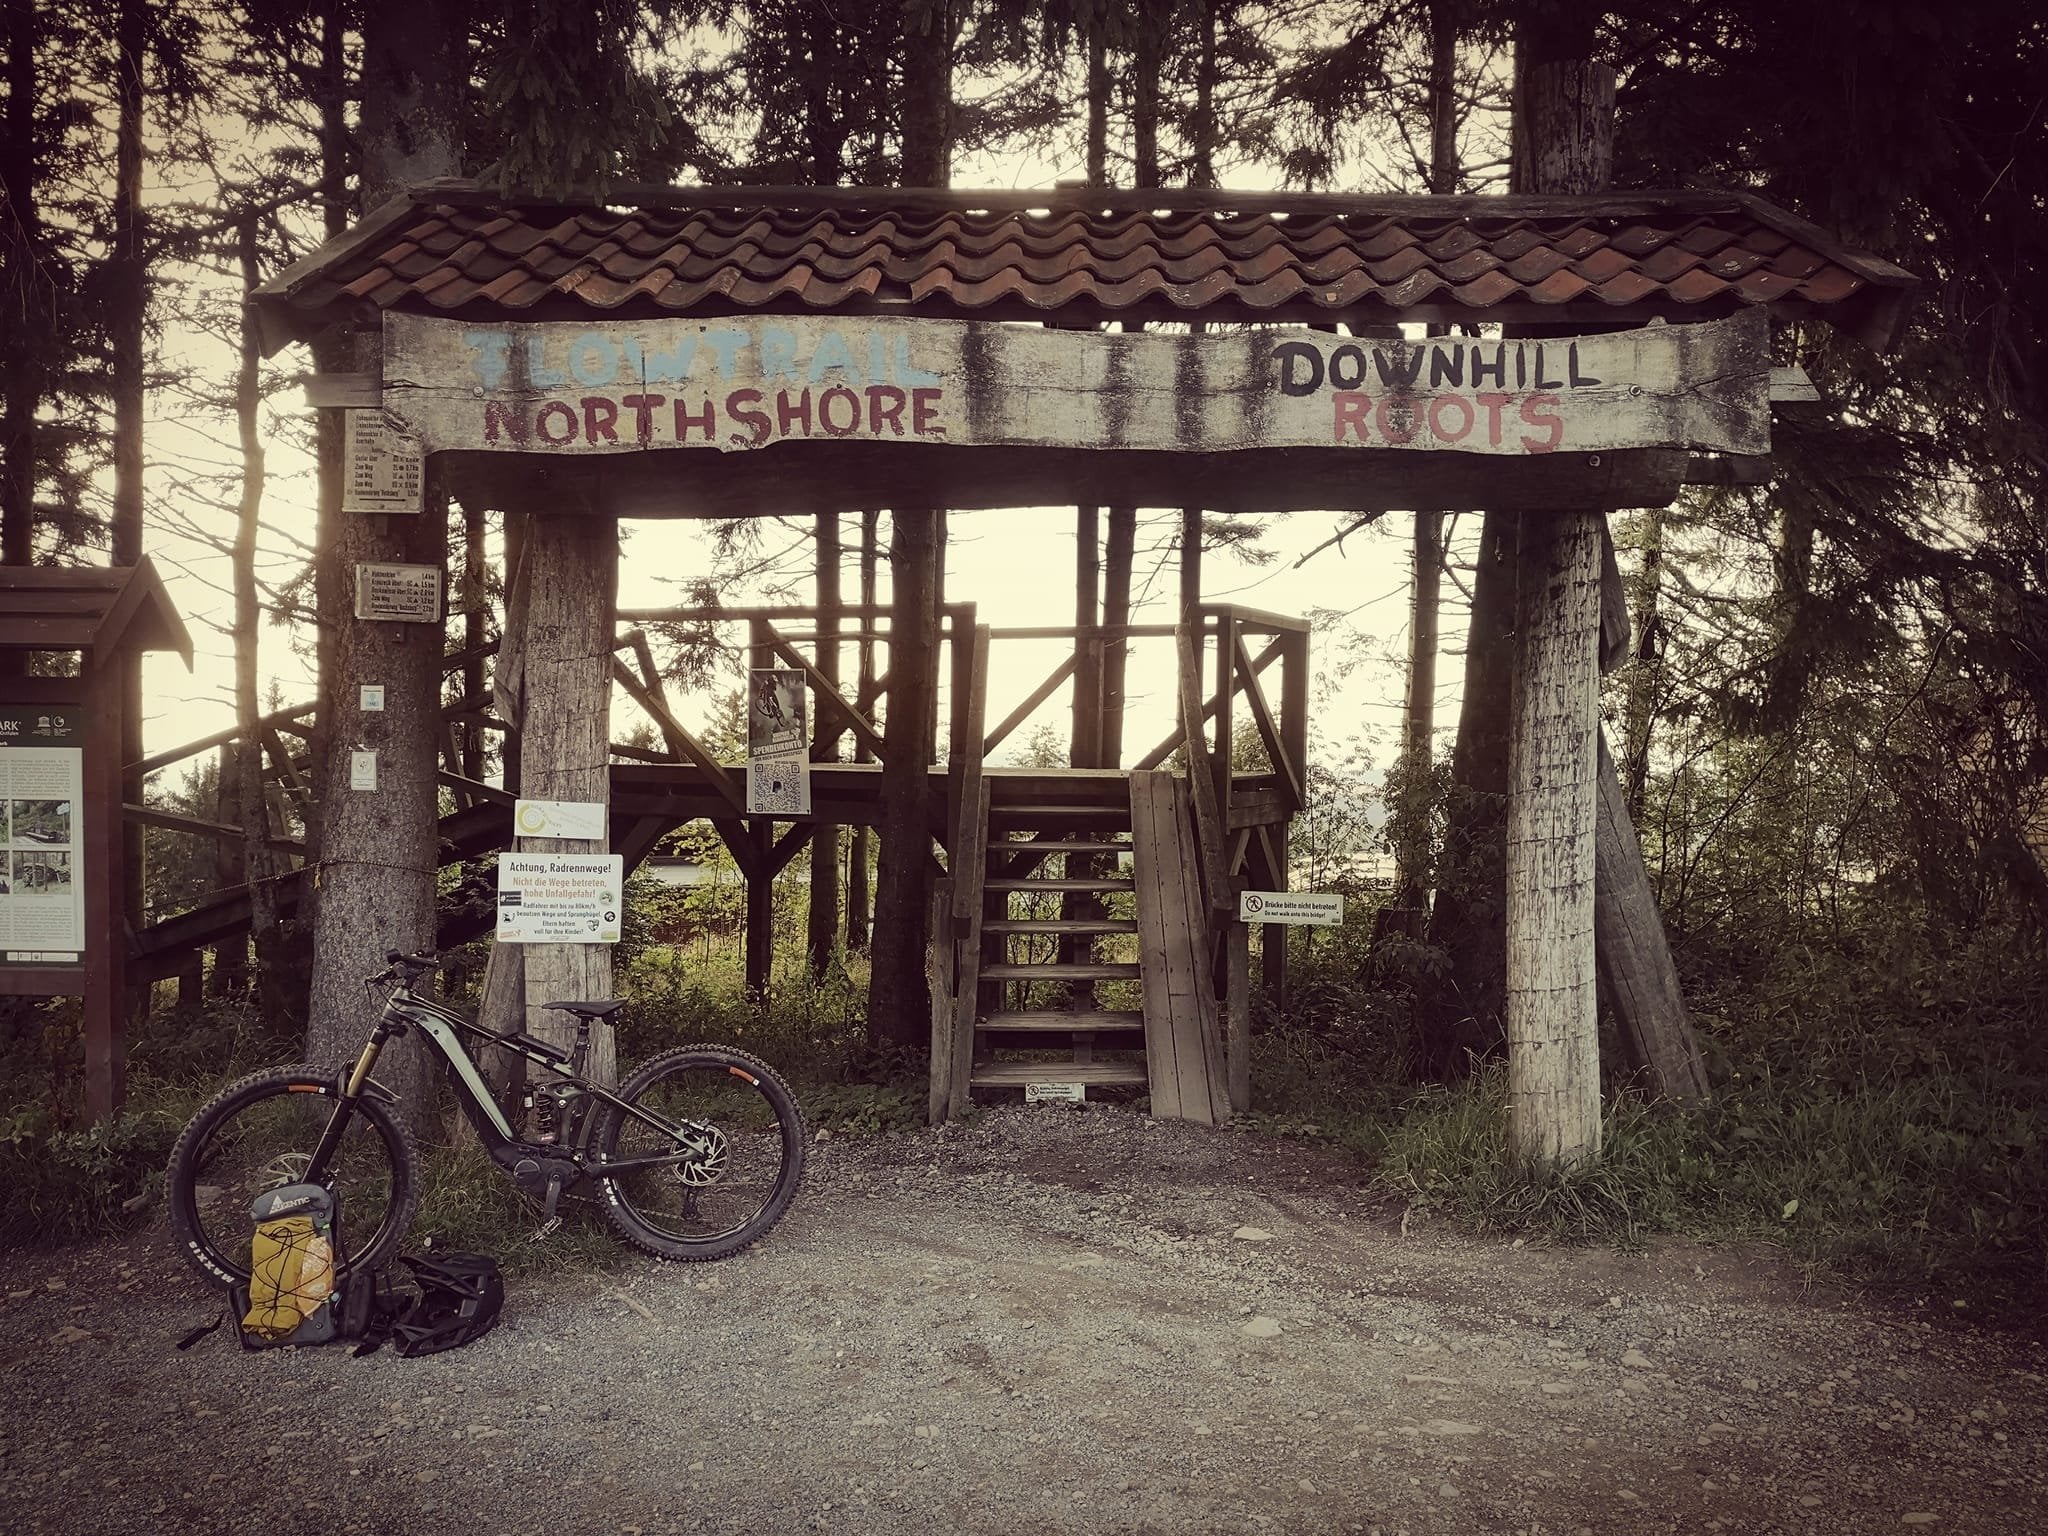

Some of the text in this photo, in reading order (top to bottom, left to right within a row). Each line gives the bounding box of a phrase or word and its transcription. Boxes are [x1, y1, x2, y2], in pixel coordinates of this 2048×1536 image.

[1272, 341, 1602, 396] DOWNHILL
[1332, 391, 1563, 454] ROOTS
[753, 740, 803, 756] SPENDENKONTO
[510, 862, 611, 874] Achtung, Radrennwege!
[512, 877, 607, 888] Nicht die Wege betreten,
[524, 888, 596, 899] hohe Unfallgefahr!
[188, 1241, 235, 1283] MAXXIS
